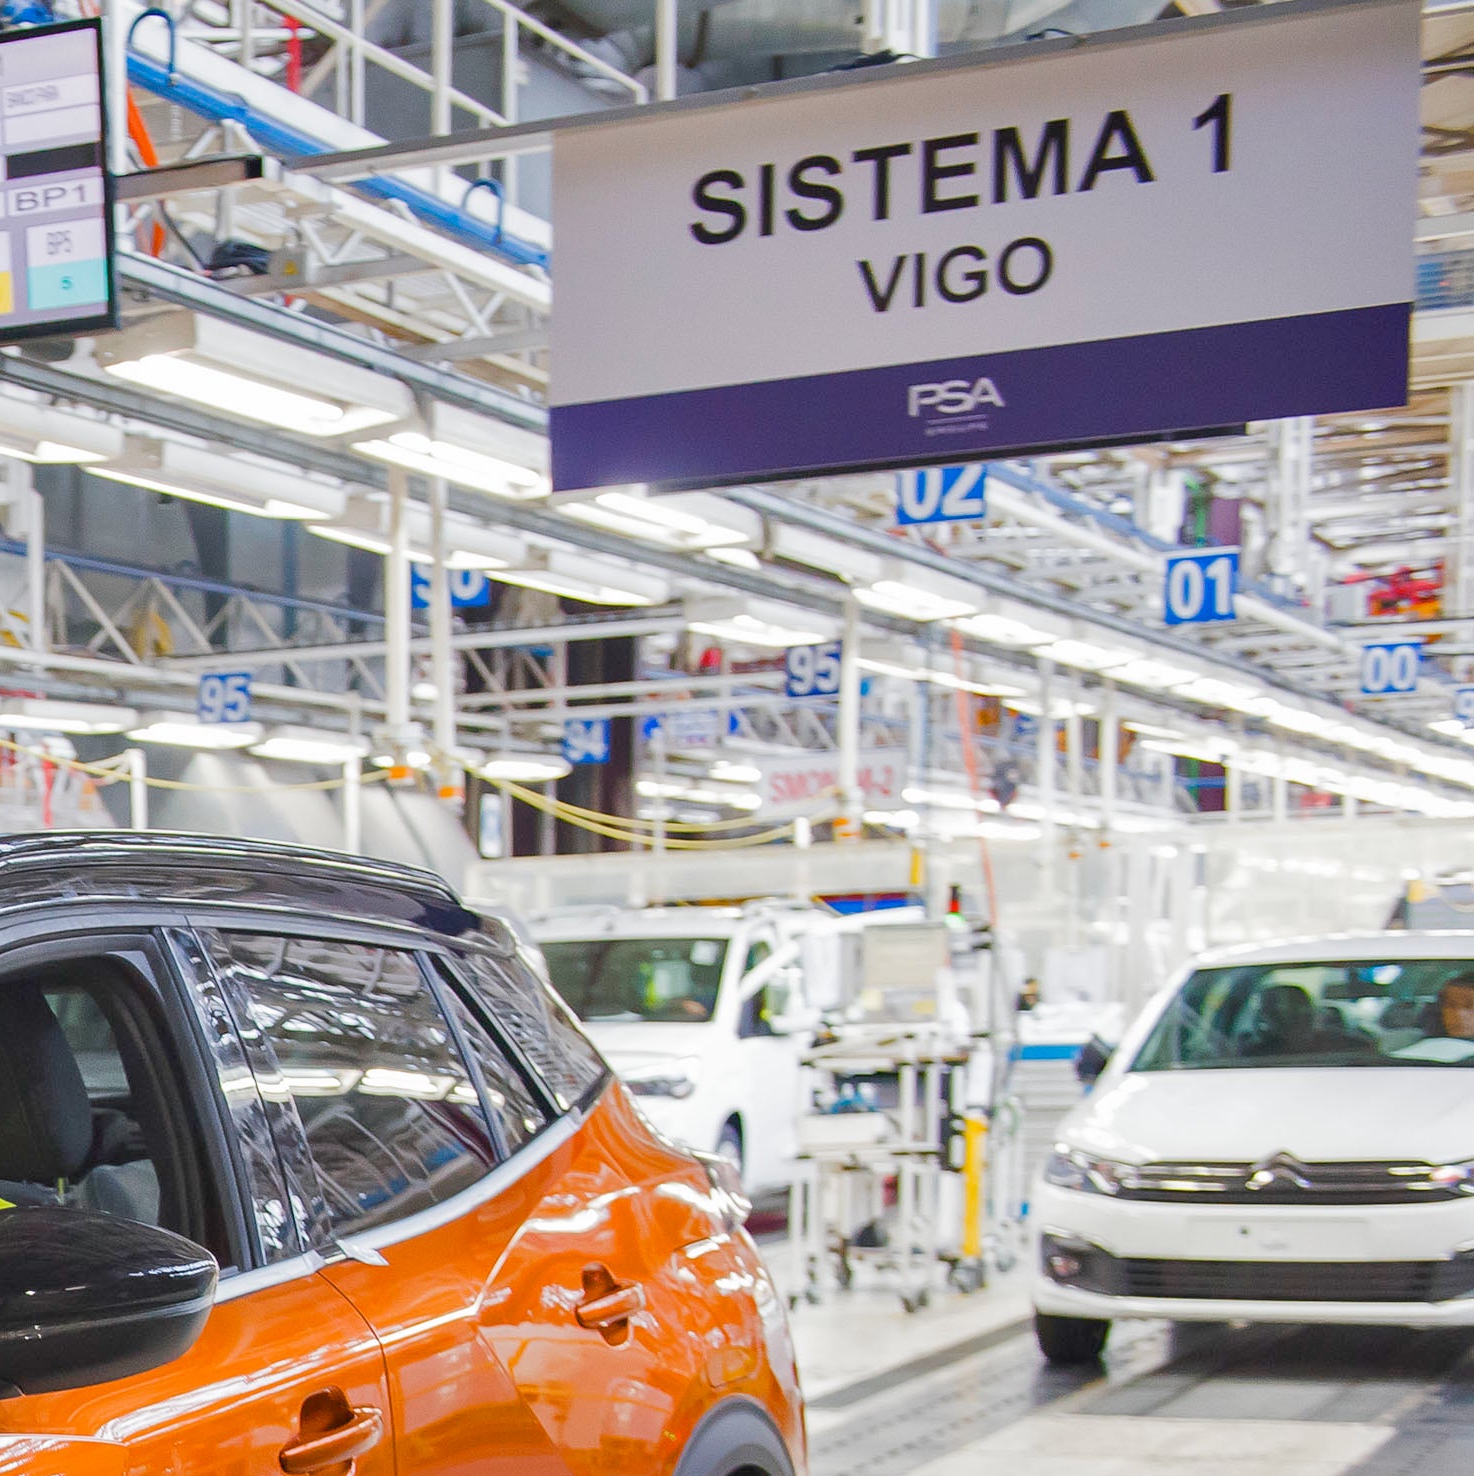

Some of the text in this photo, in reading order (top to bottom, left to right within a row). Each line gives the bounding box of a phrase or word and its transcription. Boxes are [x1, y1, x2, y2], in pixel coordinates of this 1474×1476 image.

[691, 93, 1234, 246] SISTEMA 1
[14, 184, 88, 212] BP1
[857, 236, 1054, 314] VIGO
[907, 377, 1006, 418] PSA
[899, 466, 985, 521] 02
[1168, 558, 1234, 620] 01
[786, 646, 840, 696] 95
[1362, 645, 1418, 691] 00
[200, 675, 251, 722] 95
